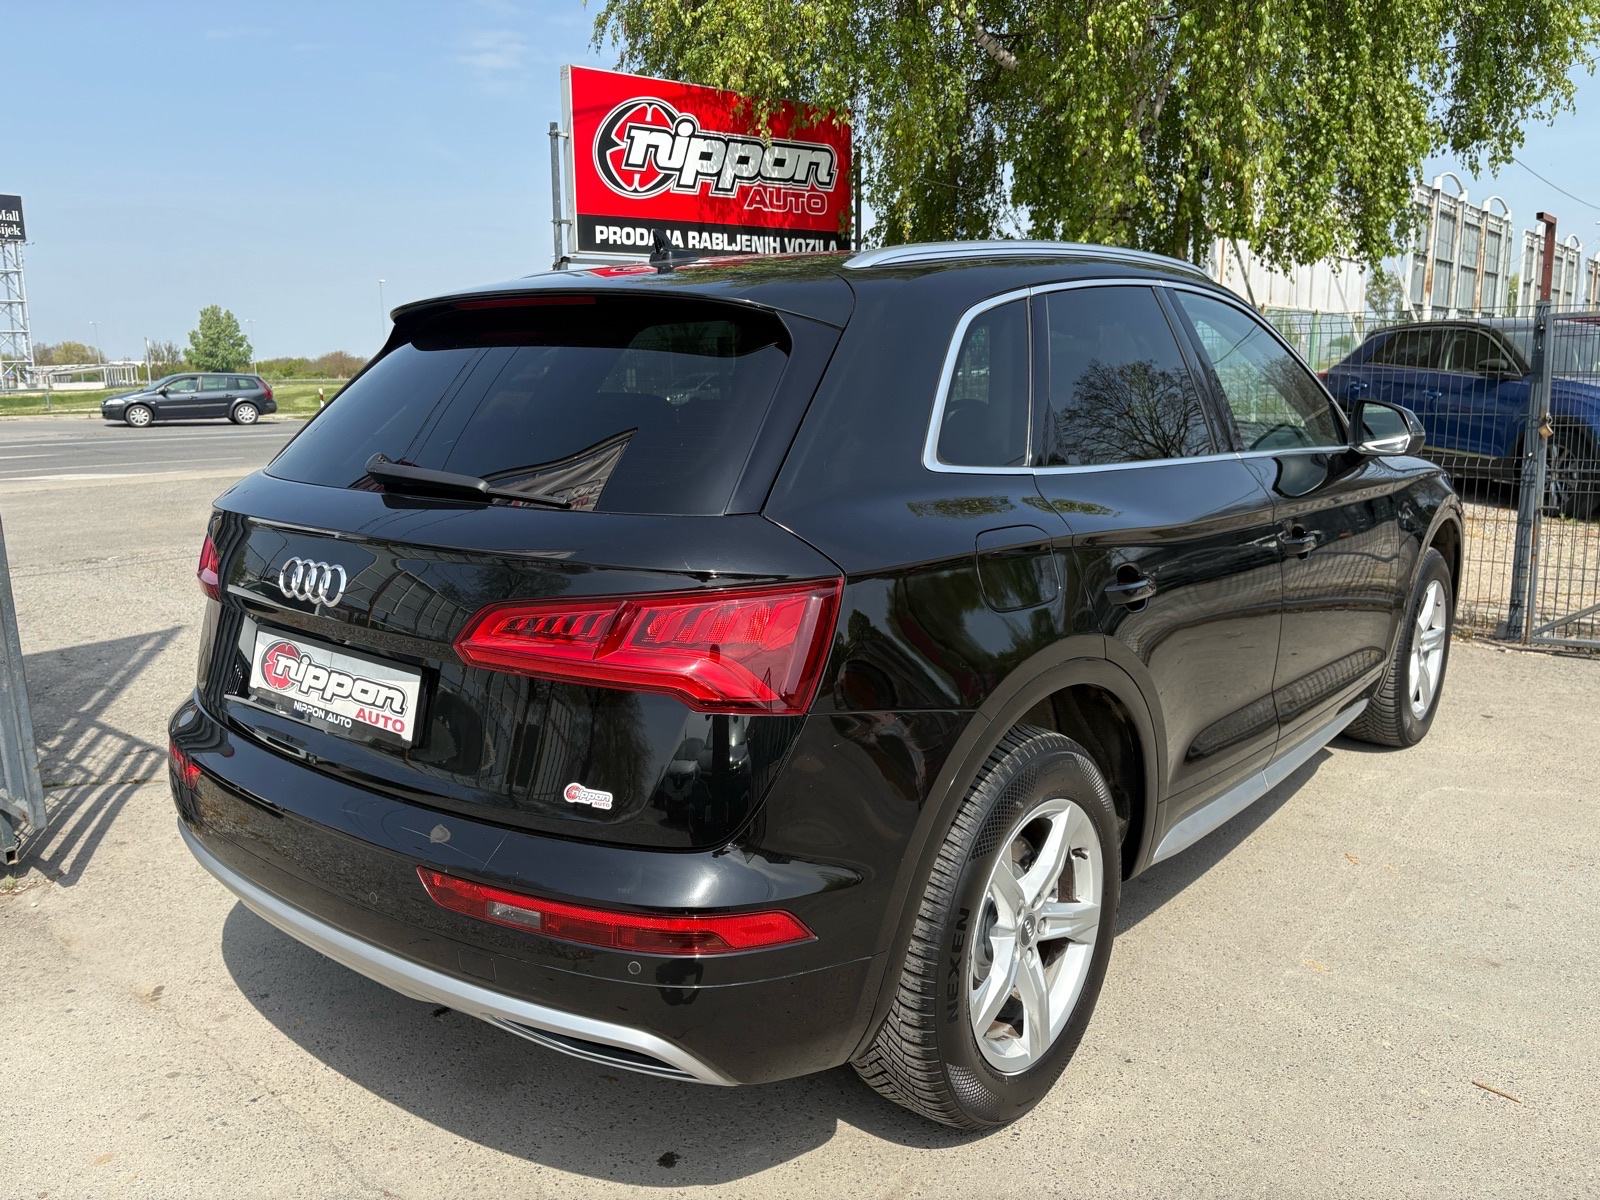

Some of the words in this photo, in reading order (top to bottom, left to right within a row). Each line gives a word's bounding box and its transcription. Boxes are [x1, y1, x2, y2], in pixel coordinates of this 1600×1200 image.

[744, 188, 828, 215] AUTO
[0, 223, 22, 238] ijek
[594, 224, 685, 249] PRODA
[687, 230, 781, 255] RABLJENIH
[784, 237, 838, 254] VOZILA
[293, 701, 326, 720] NIPPON
[325, 712, 353, 729] AUTO
[355, 707, 406, 734] AUTO
[946, 907, 971, 1025] NEXEN
